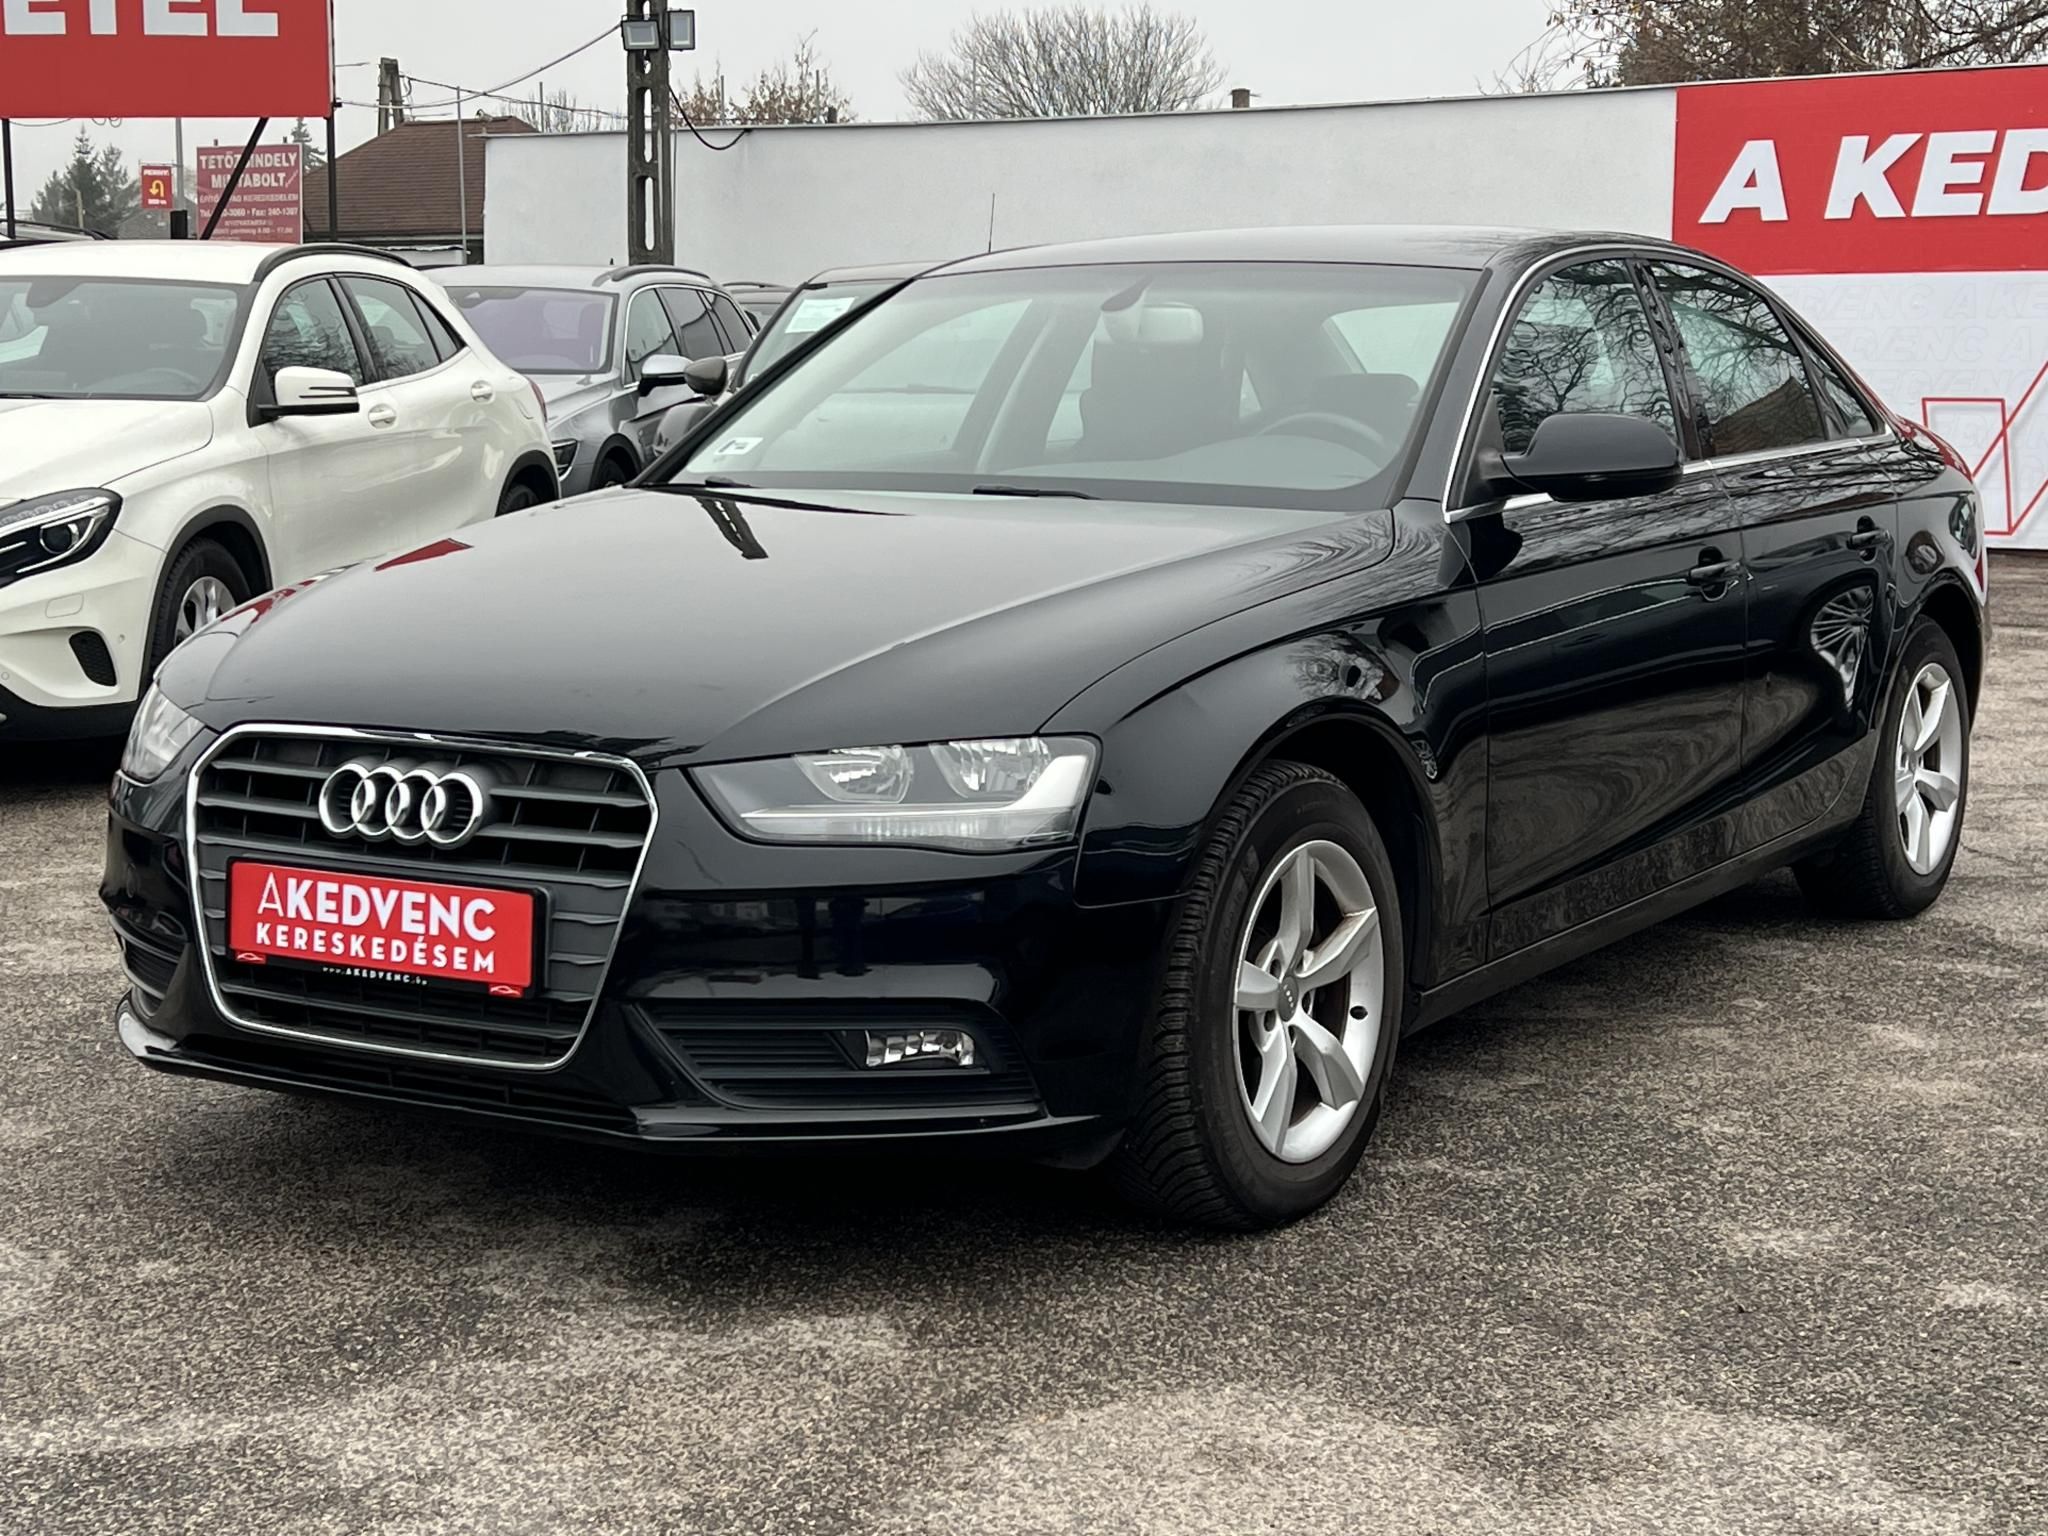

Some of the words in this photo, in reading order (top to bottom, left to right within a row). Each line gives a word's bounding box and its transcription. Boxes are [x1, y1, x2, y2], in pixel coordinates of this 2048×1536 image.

[211, 172, 286, 189] MITABOLT
[1698, 139, 1788, 225] A
[1823, 127, 2048, 219] KED
[256, 922, 495, 974] KERESKEDÉSEM
